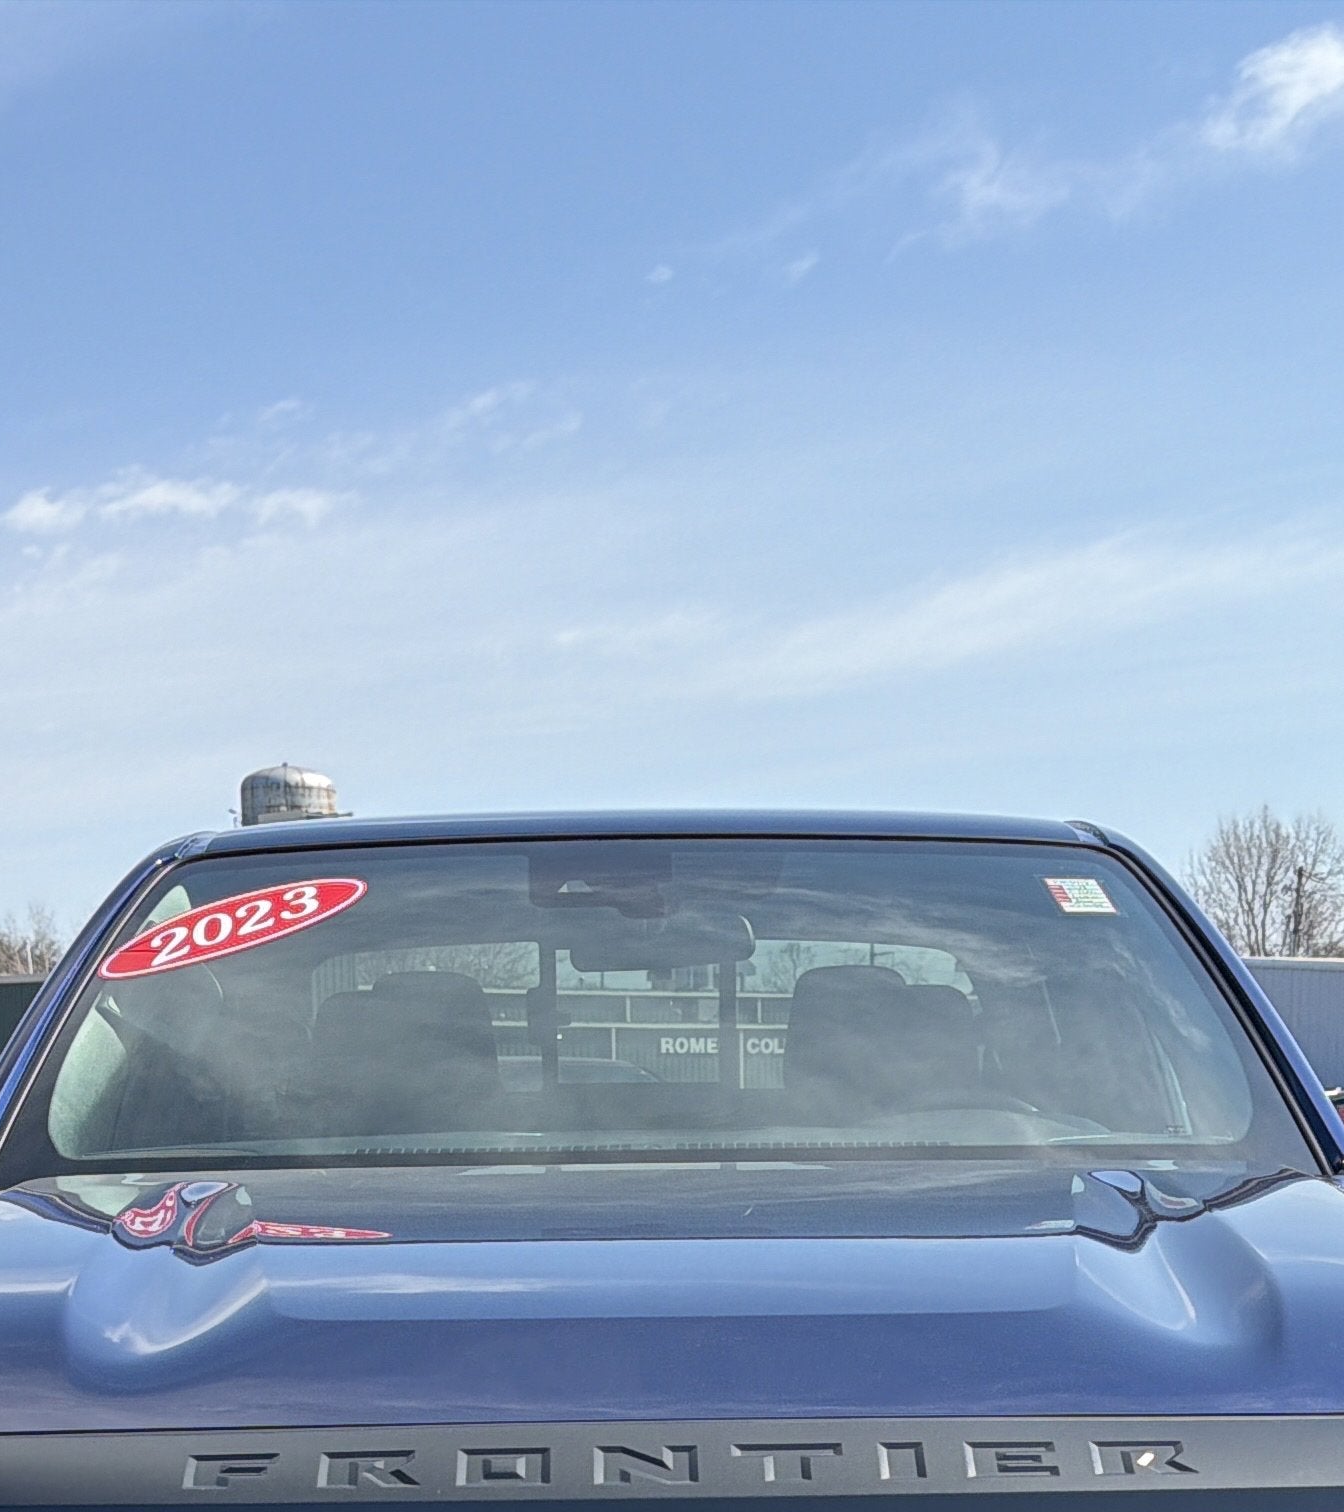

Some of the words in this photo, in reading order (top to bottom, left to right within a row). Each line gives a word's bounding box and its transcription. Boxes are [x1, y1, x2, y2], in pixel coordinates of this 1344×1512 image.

[150, 886, 320, 968] 2023
[746, 1037, 787, 1054] COL
[182, 1440, 1199, 1489] FRONTIER
